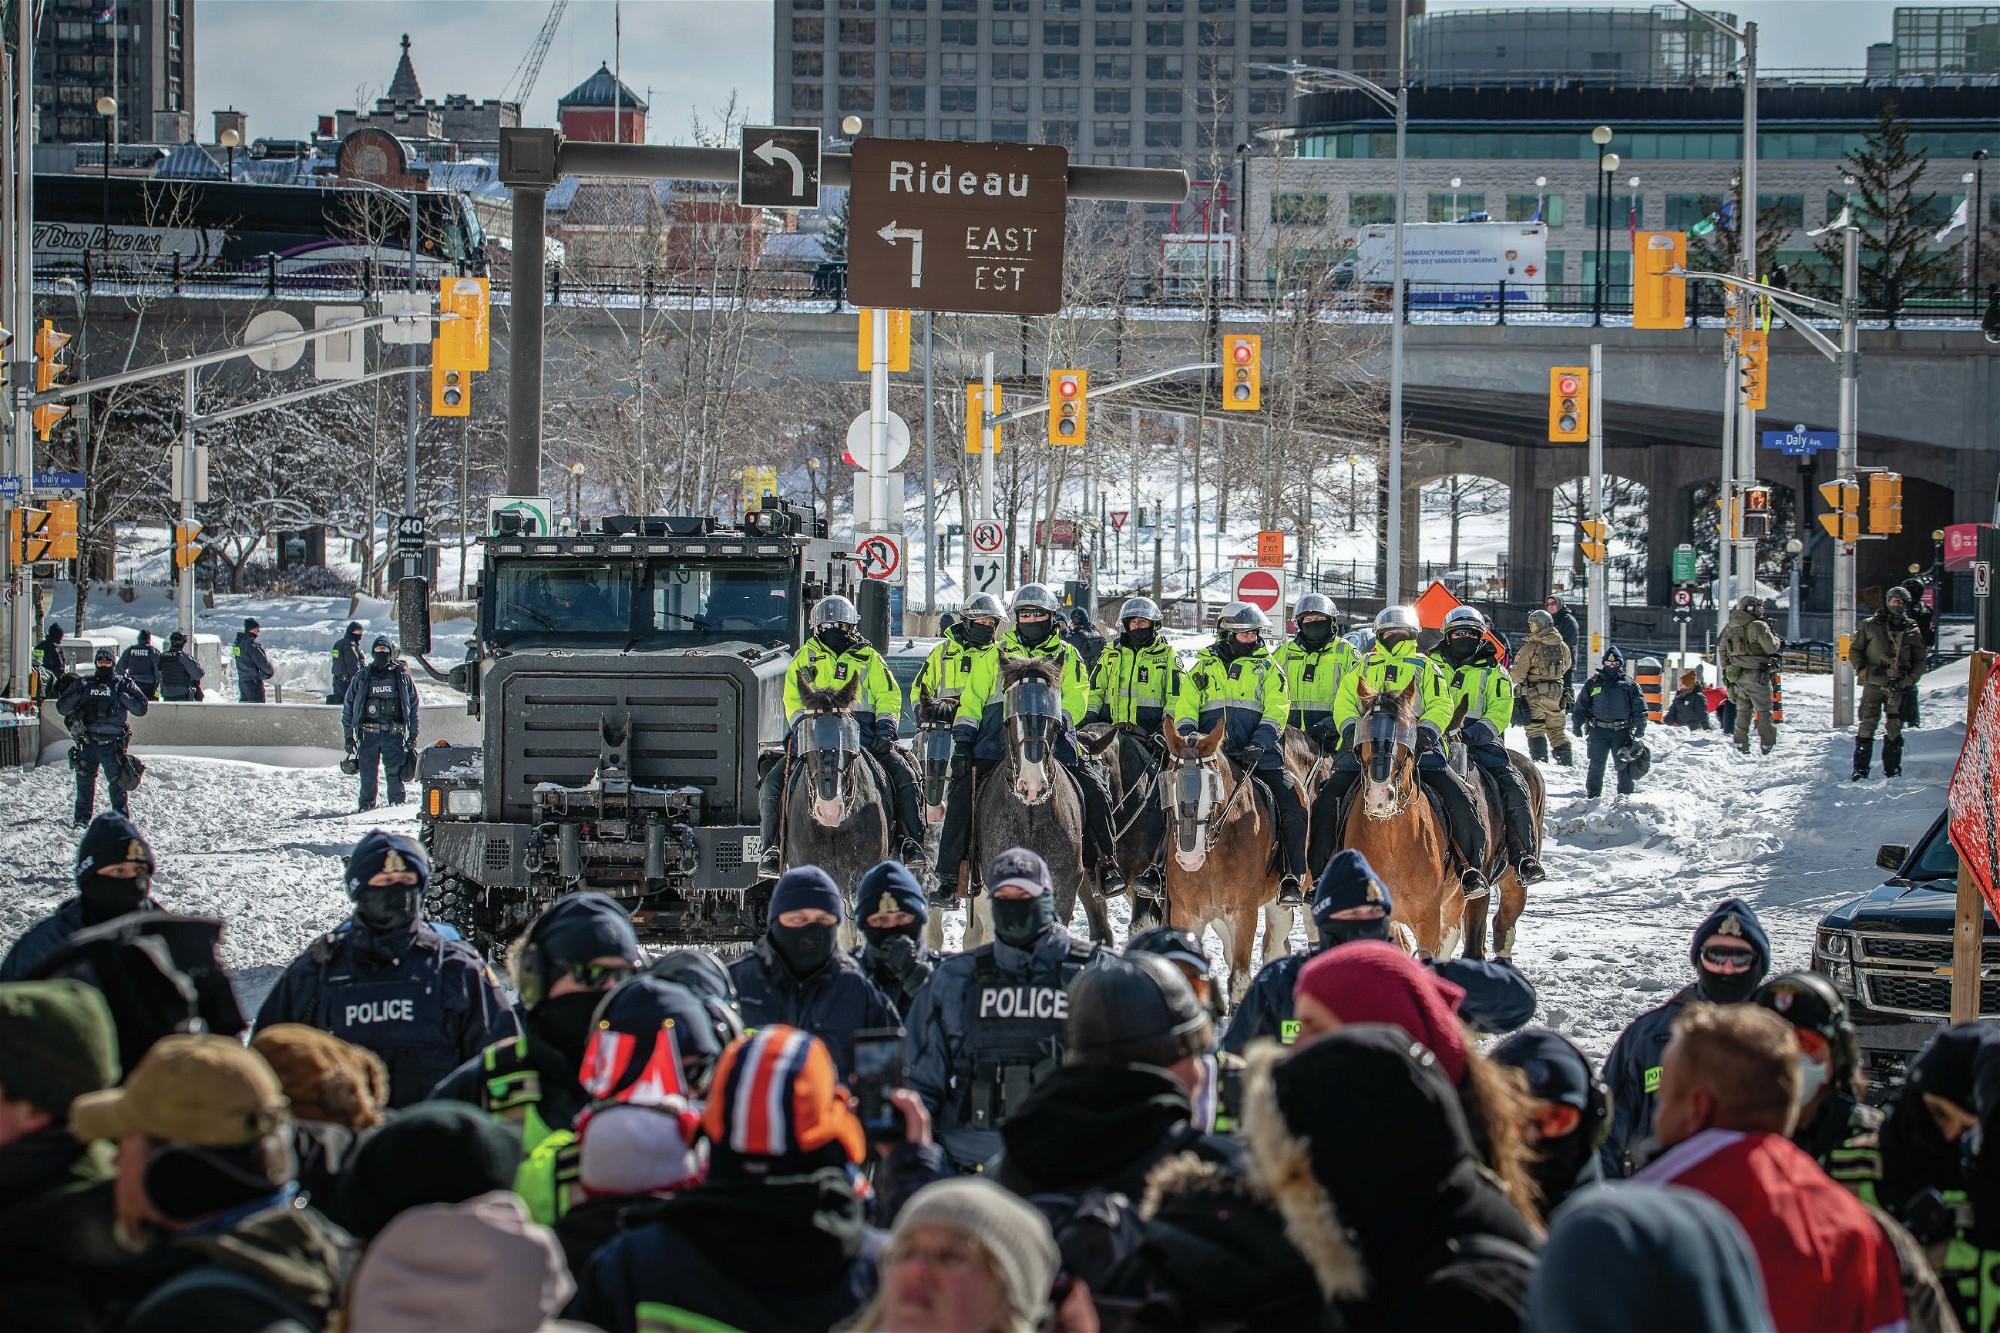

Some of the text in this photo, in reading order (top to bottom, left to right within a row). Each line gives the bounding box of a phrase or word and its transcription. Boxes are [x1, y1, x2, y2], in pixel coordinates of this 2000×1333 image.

[889, 161, 1029, 197] Rideau
[47, 223, 88, 249] Bus
[87, 227, 134, 251] Line
[965, 226, 1038, 251] EAST
[975, 266, 1025, 291] EST
[1786, 434, 1807, 448] Daly
[42, 474, 59, 485] Daly
[400, 519, 423, 534] 40
[1266, 535, 1276, 543] NO
[372, 686, 392, 694] POLICE
[345, 998, 415, 1027] POLICE
[980, 987, 1070, 1019] POLICE
